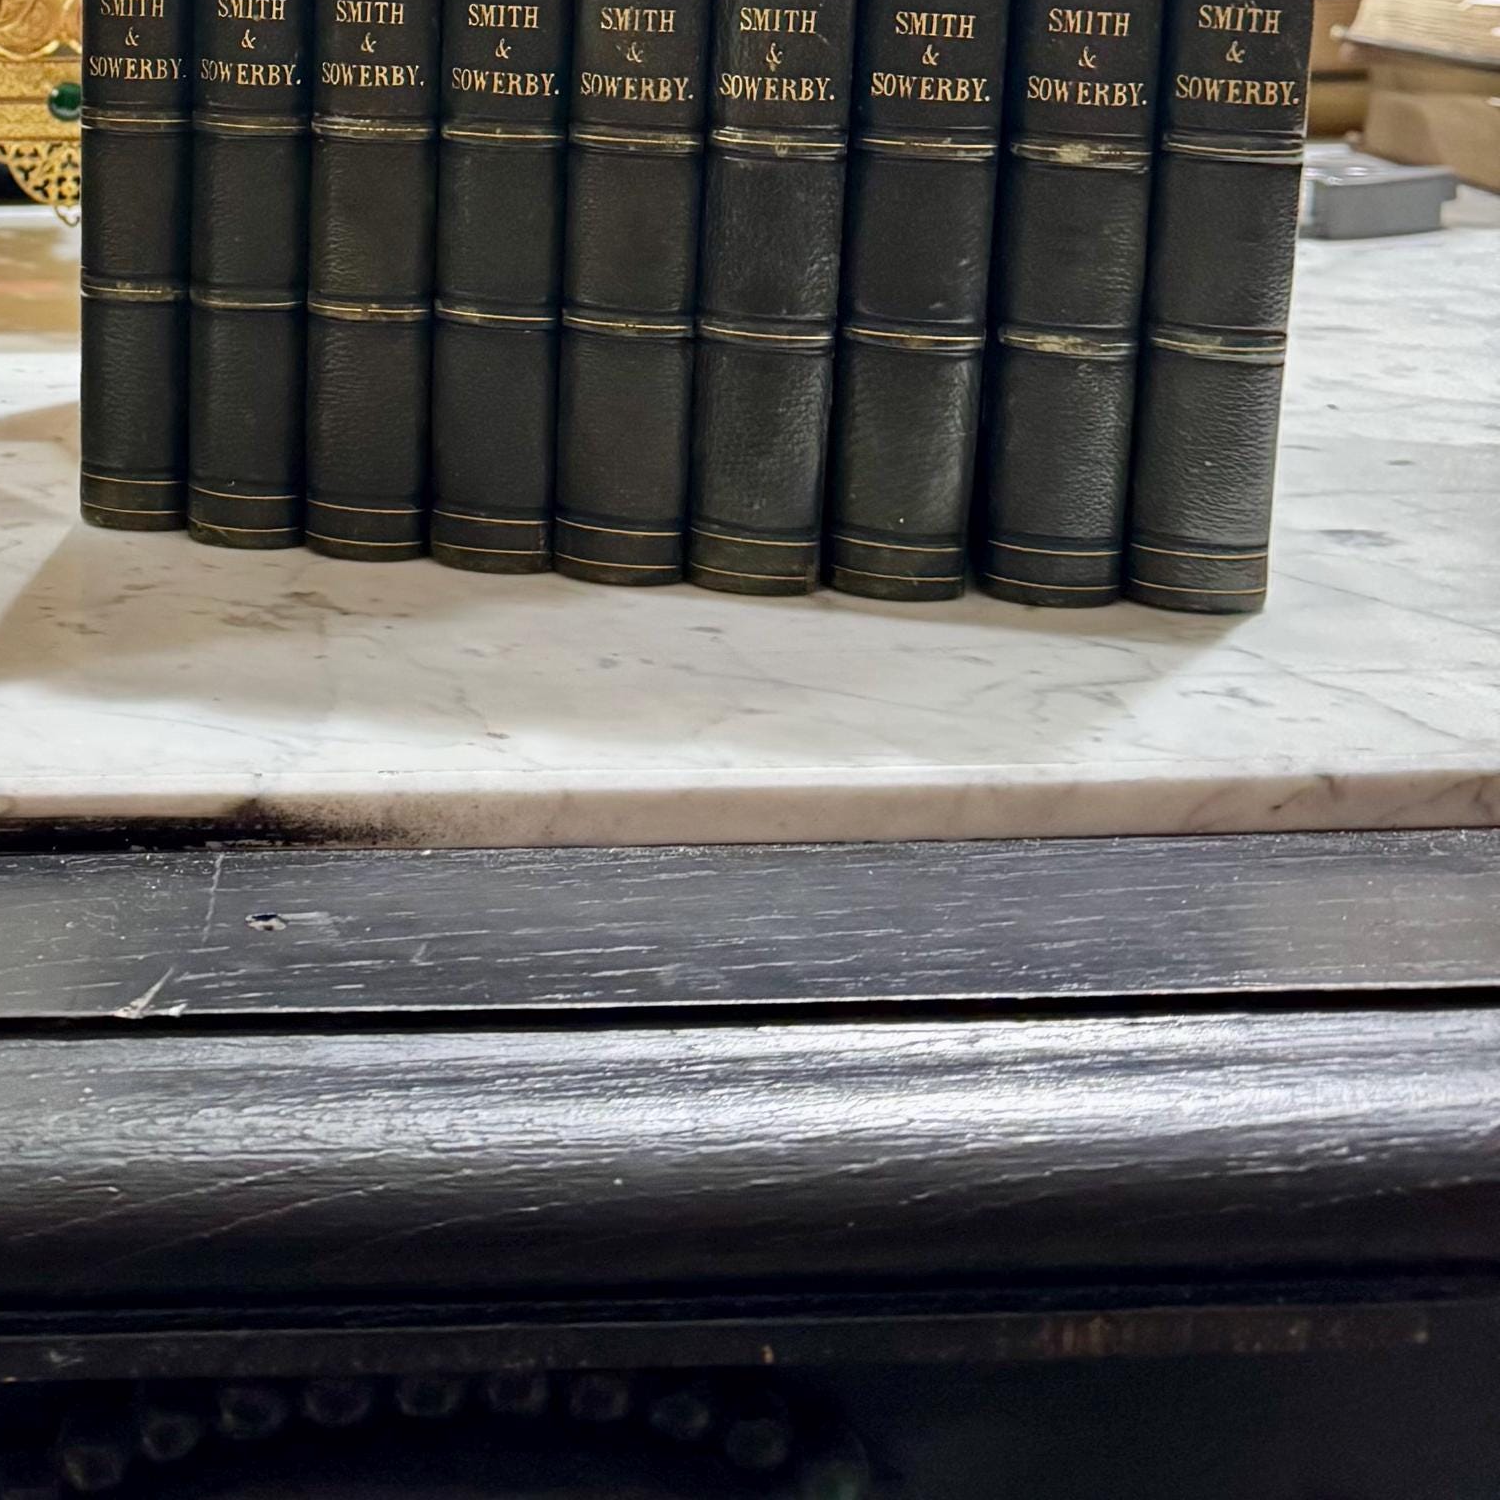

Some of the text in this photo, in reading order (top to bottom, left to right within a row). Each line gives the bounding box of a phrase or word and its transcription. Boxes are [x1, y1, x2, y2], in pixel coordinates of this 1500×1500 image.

[336, 1, 404, 24] SMITH
[469, 4, 539, 29] SMITH
[600, 8, 676, 32] SMITH
[740, 8, 817, 33] SMITH
[1048, 9, 1130, 36] SMITH
[1198, 6, 1281, 34] SMITH
[126, 27, 140, 47] &
[895, 12, 976, 38] SMITH
[242, 30, 256, 49] &
[361, 35, 377, 54] &
[496, 38, 512, 59] &
[1226, 41, 1245, 62] &
[627, 42, 644, 62] &
[765, 44, 783, 65] &
[921, 44, 939, 65] &
[1078, 48, 1096, 69] &
[201, 61, 301, 85] SOWERBY.
[322, 63, 424, 88] SOWERBY.
[452, 71, 559, 96] SOWERBY.
[580, 76, 693, 101] SOWERBY.
[720, 75, 834, 101] SOWERBY.
[871, 73, 990, 102] SOWERBY.
[1027, 76, 1147, 106] SOWERBY.
[1175, 75, 1299, 105] SOWERBY.
